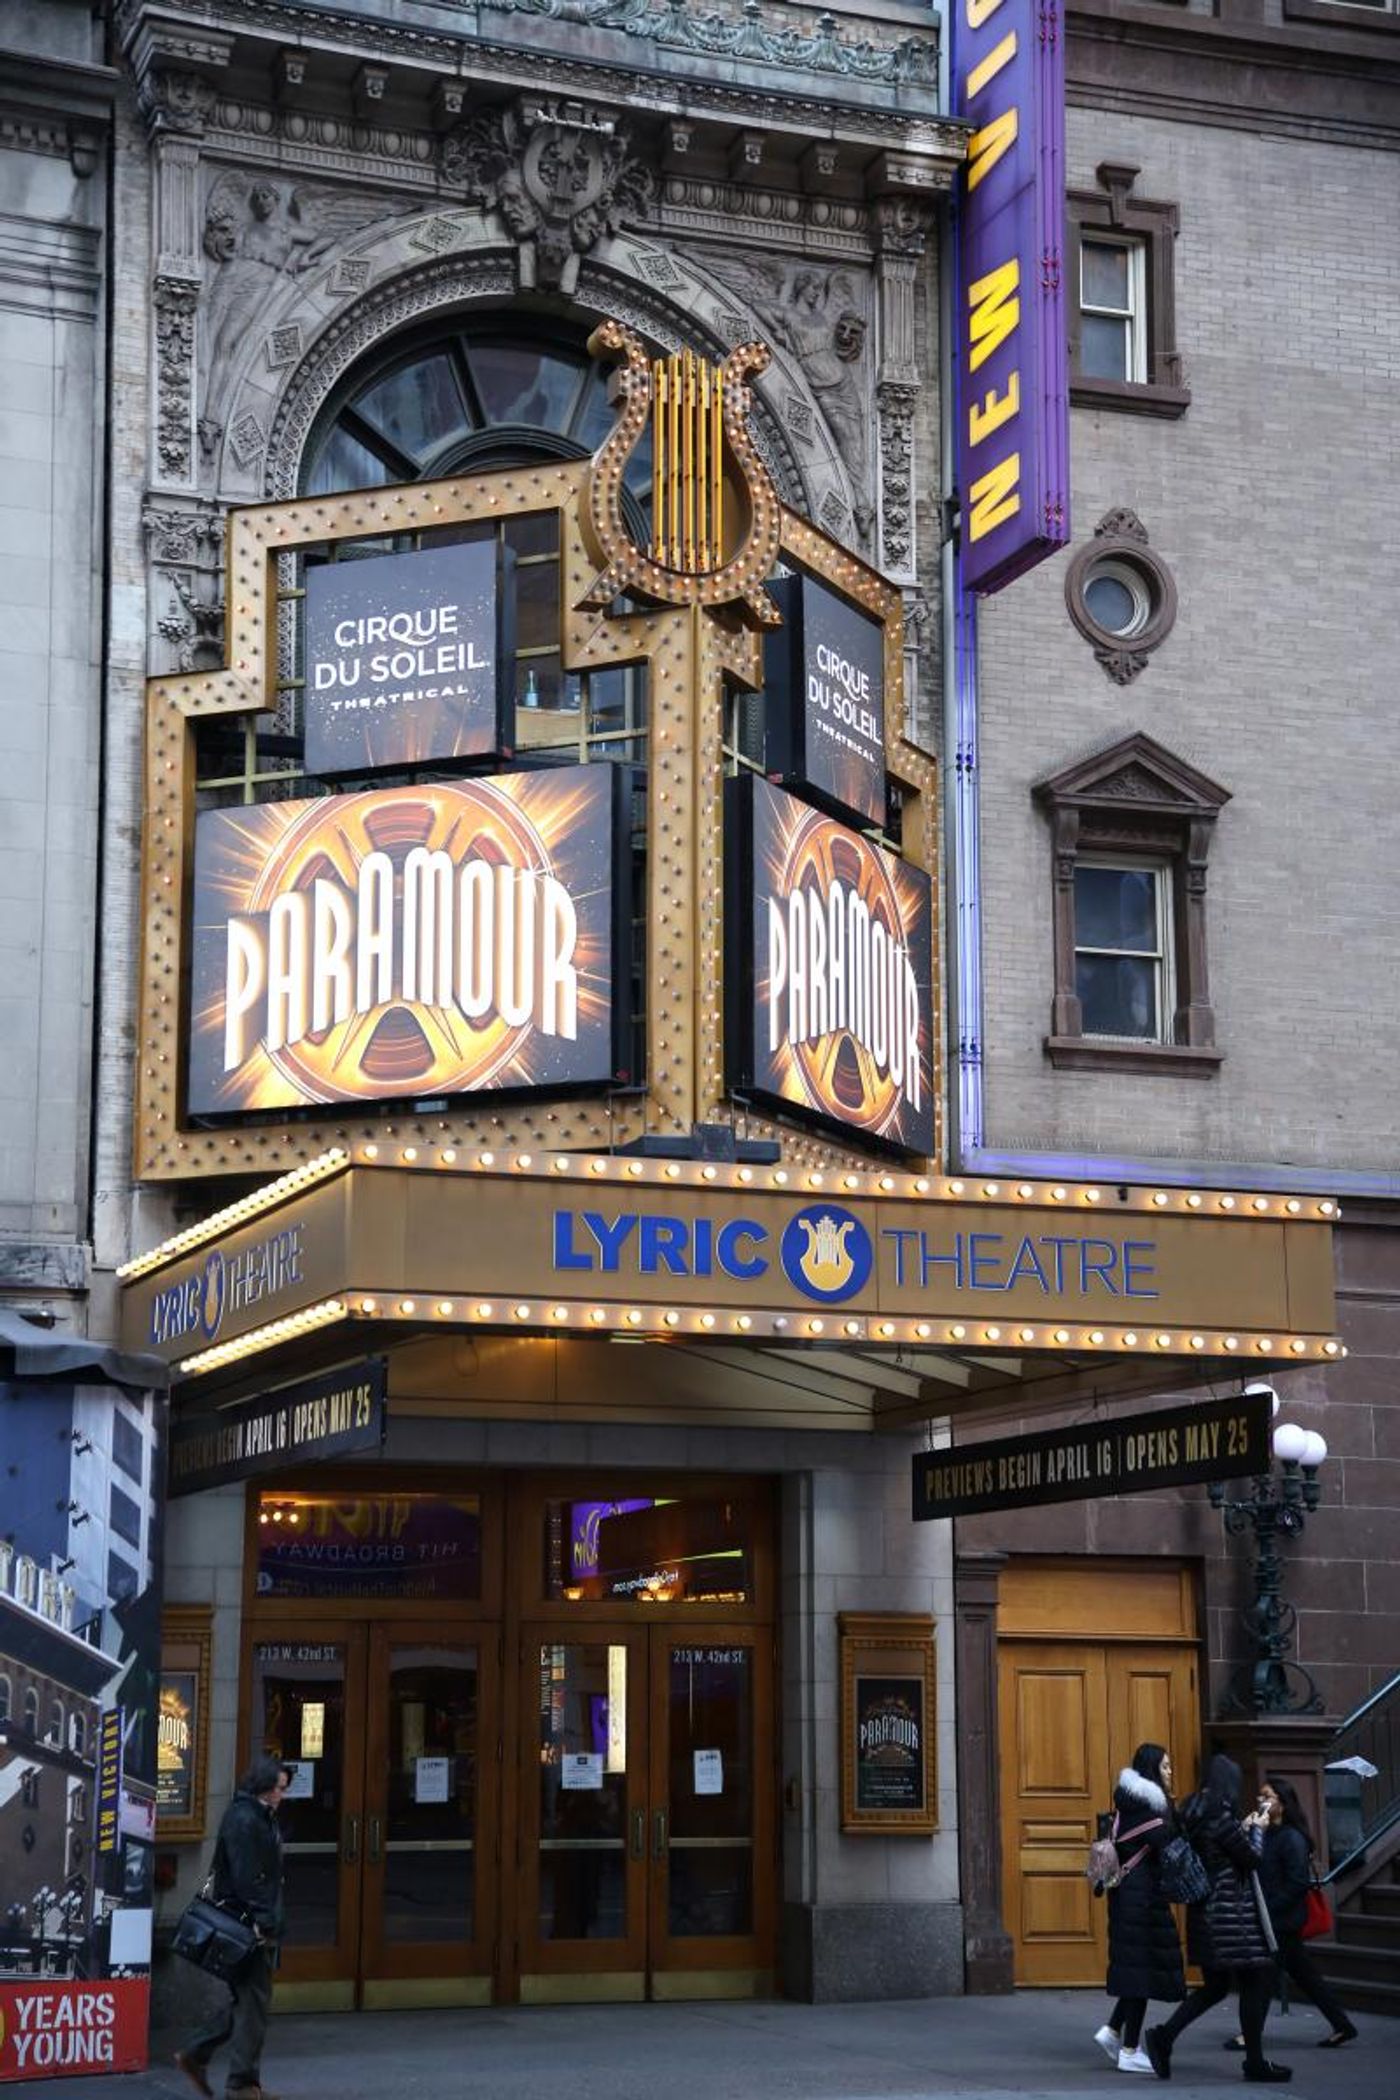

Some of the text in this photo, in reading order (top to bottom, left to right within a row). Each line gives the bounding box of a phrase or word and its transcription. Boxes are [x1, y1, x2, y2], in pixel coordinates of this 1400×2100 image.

[968, 257, 1020, 543] NEW
[334, 605, 459, 647] CIRQUE
[314, 642, 486, 690] DU SOLEIL
[331, 684, 469, 711] THEATRICAL
[817, 644, 869, 703] CIRQUE
[808, 675, 883, 746] DU SOLEIL
[815, 718, 875, 762] THEATRICAL
[224, 847, 578, 1073] PARAMOUR
[768, 880, 921, 1112] PARAMOUR
[149, 1223, 306, 1344] LYRIC THEATRE
[553, 1210, 1160, 1298] LYRIC THEATRE
[244, 1412, 272, 1457] APRIL
[276, 1409, 287, 1449] 16
[293, 1398, 327, 1444] OPENS
[329, 1389, 354, 1434] MAY
[356, 1384, 372, 1428] 25
[926, 1416, 1249, 1500] PREVIEWS BEGIN APRIL 16 OPENS MAY 25
[100, 1713, 119, 1851] NEW VICTORY
[14, 1992, 116, 2031] YEARS
[12, 2029, 114, 2067] YOUNG
